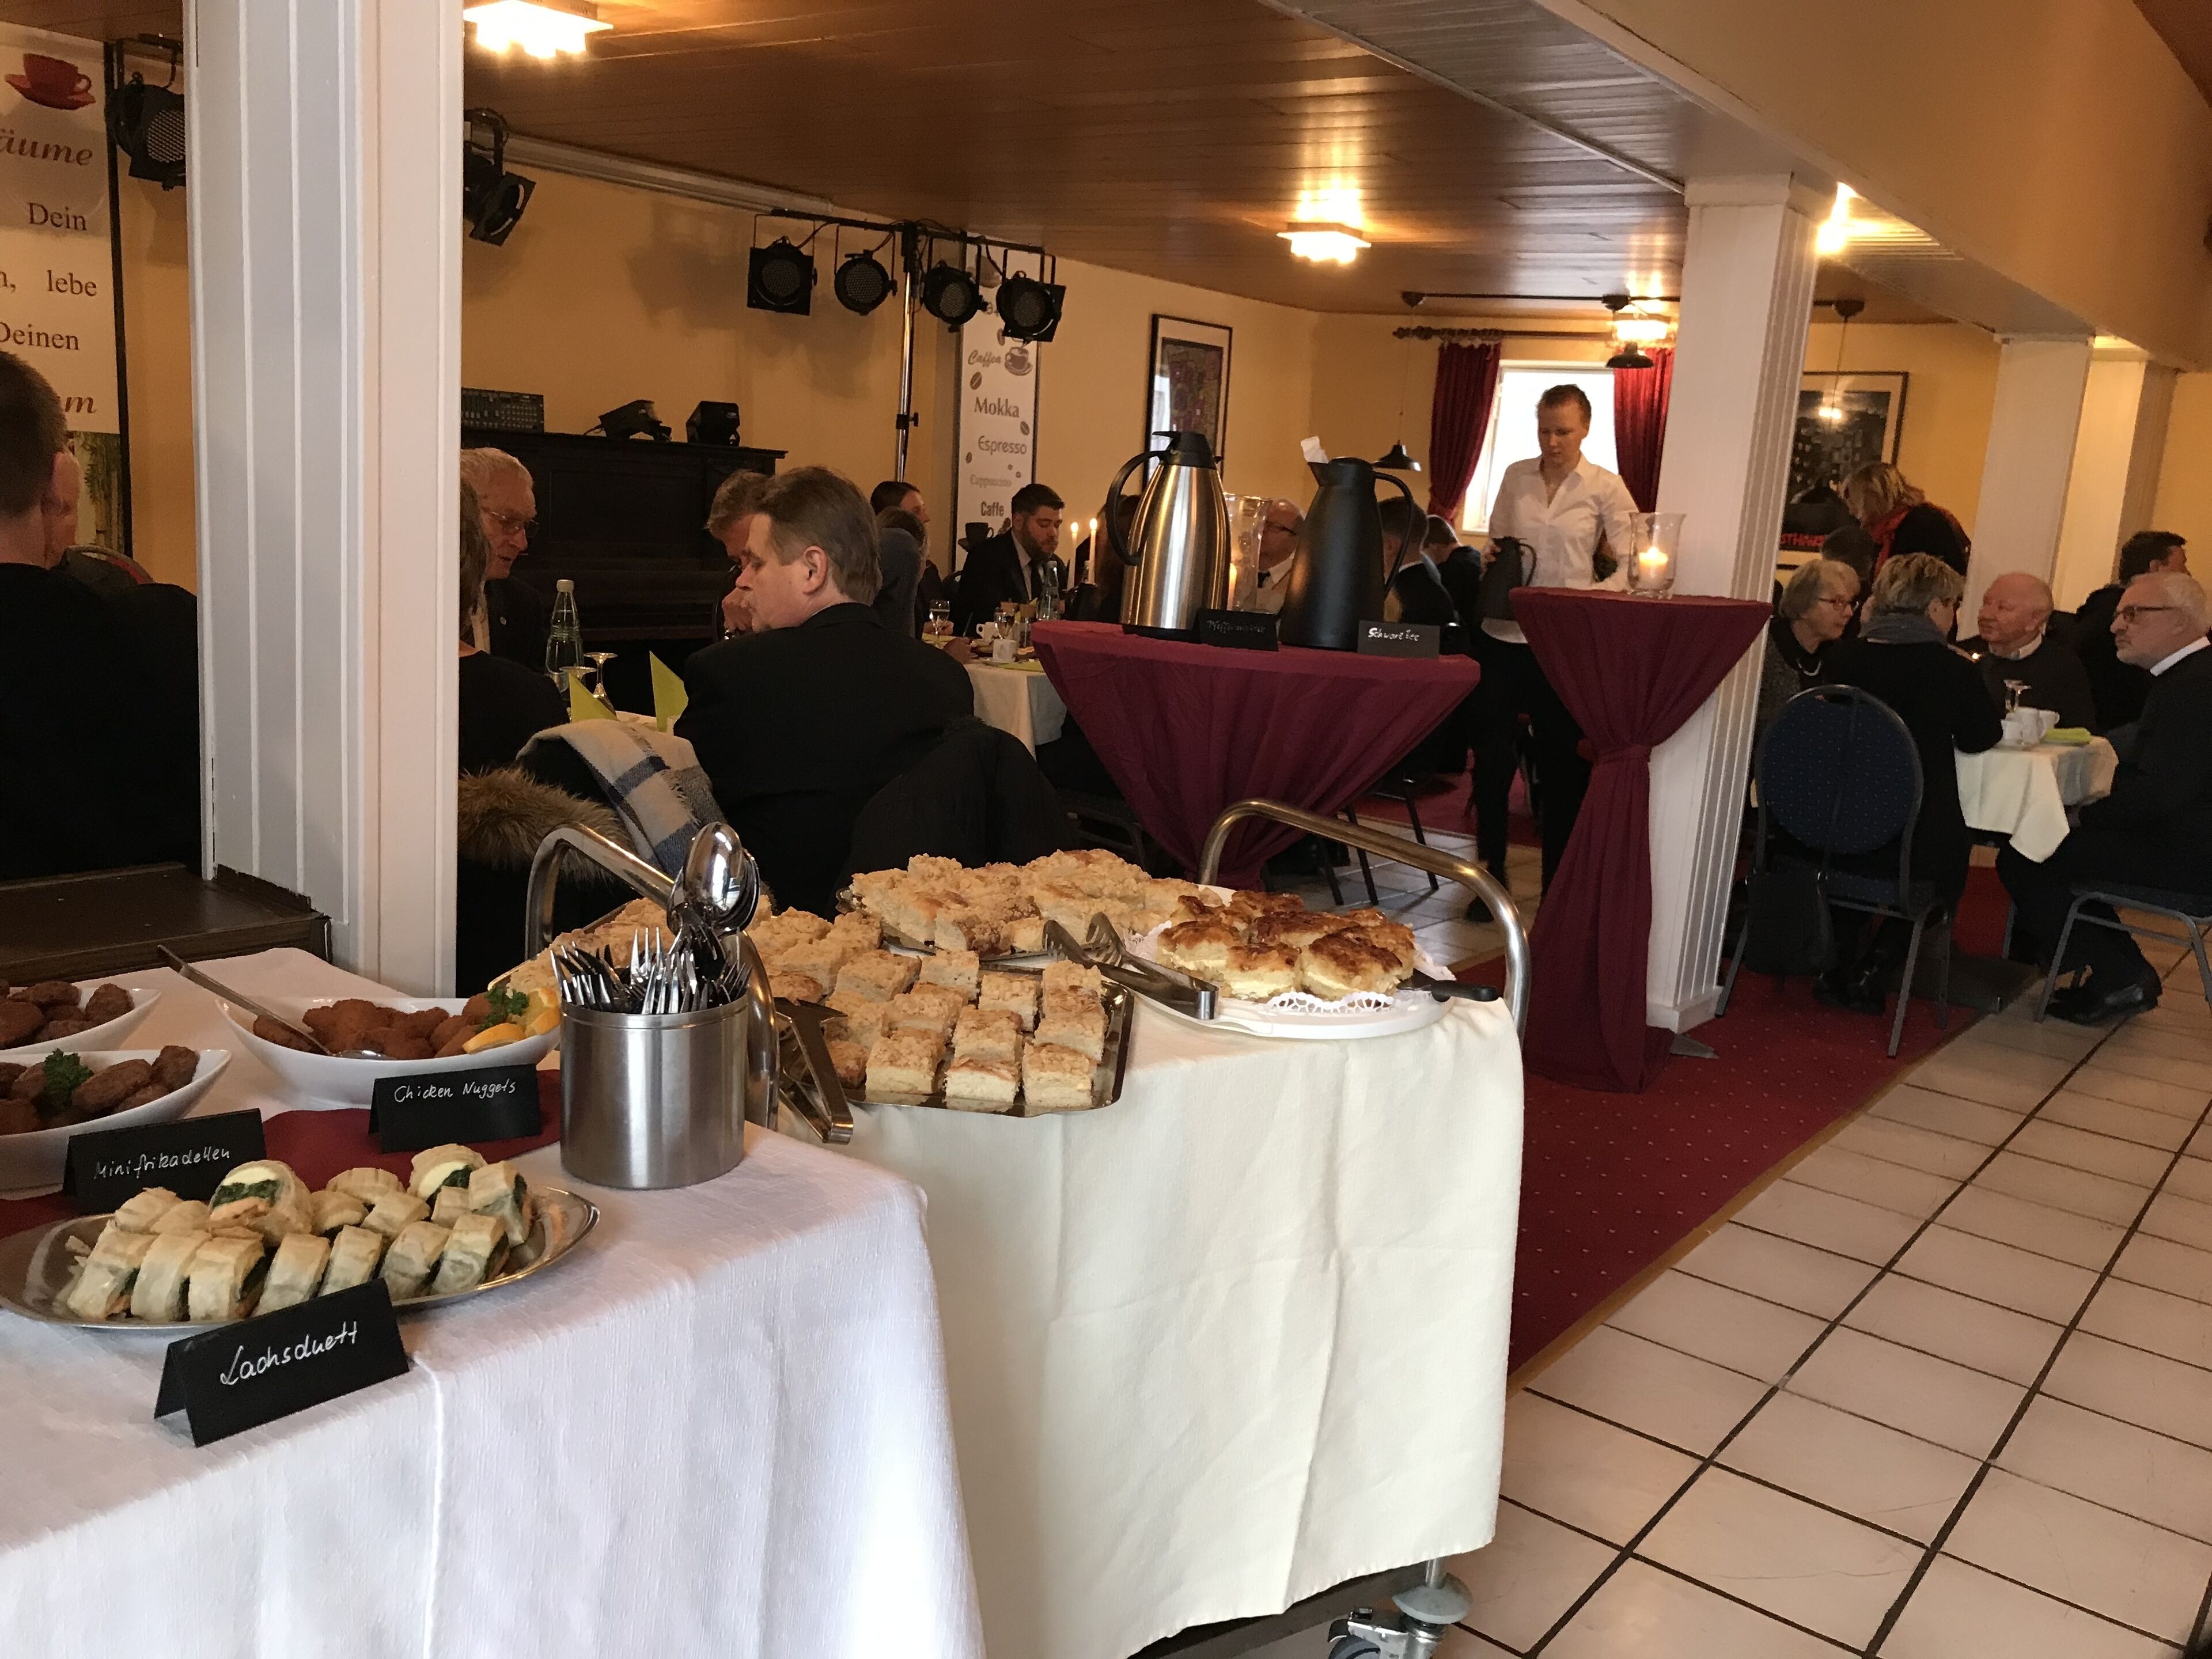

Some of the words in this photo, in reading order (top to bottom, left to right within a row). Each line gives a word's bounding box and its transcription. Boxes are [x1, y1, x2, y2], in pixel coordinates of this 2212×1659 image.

[28, 202, 87, 230] Dein
[47, 269, 97, 297] lebe
[974, 397, 1020, 418] Mokka
[978, 435, 1027, 456] Espresso
[970, 474, 1012, 488] Cappuccino
[980, 501, 1004, 517] Caffe
[394, 1084, 453, 1103] Chicken
[463, 1078, 516, 1099] Nuggets
[93, 1145, 230, 1180] Minifrikadellen
[220, 1321, 358, 1385] Lachsduett
